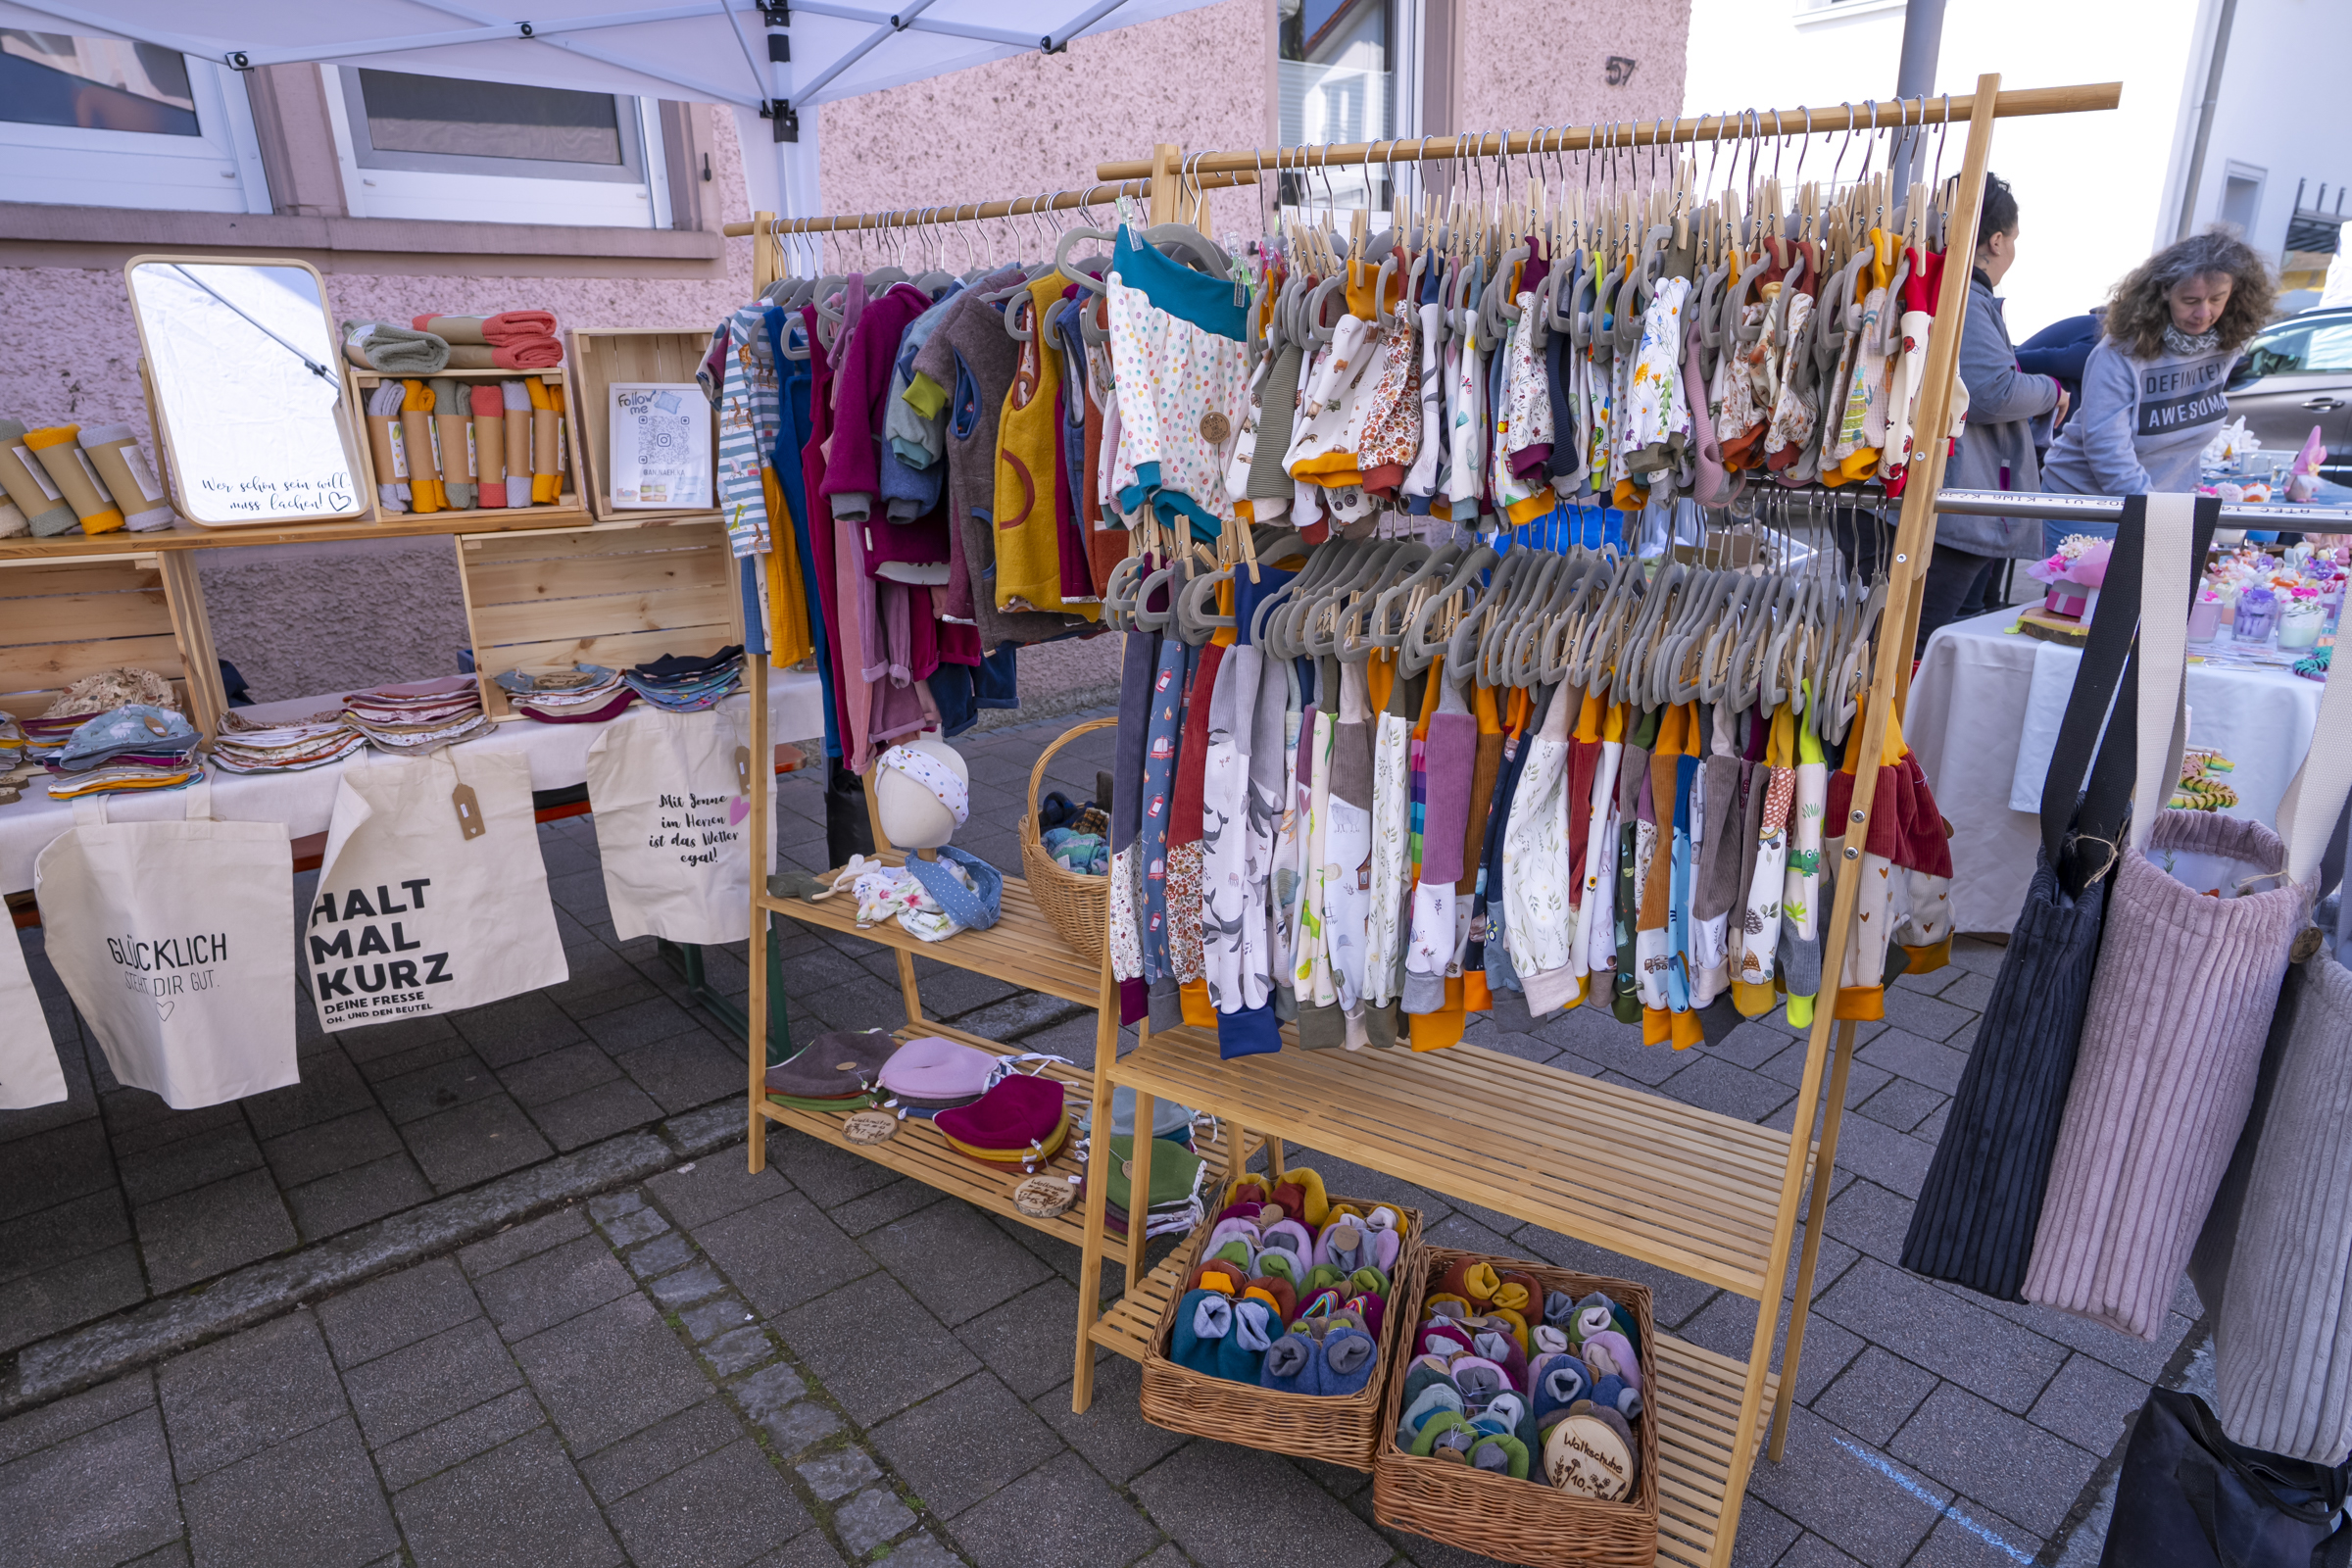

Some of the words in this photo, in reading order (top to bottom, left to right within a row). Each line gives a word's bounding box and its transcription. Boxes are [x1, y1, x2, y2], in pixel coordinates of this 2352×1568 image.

[1606, 56, 1636, 85] 57
[618, 390, 654, 407] Follow
[630, 405, 648, 415] me
[202, 479, 233, 492] Wer
[284, 479, 311, 491] sein
[229, 500, 261, 511] muss
[270, 492, 323, 512] lachen!
[659, 794, 684, 808] Mit
[689, 793, 727, 808] Sonne
[662, 816, 681, 829] im
[649, 835, 665, 849] ist
[671, 833, 696, 848] das
[702, 831, 739, 846] Wetter
[680, 847, 718, 867] egal!
[312, 878, 431, 929] HALT
[107, 933, 226, 971] GLÜCKLICH
[309, 921, 420, 965] MAL
[124, 971, 149, 995] STEHT
[153, 975, 184, 997] DIR
[190, 969, 220, 991] GUT.
[317, 952, 453, 1001] KURZ
[323, 998, 368, 1014] DEINE
[372, 991, 424, 1006] FRESSE
[372, 1007, 393, 1016] DEN
[396, 1003, 433, 1013] BEUTEL
[1563, 1432, 1624, 1474] Walkschuhe
